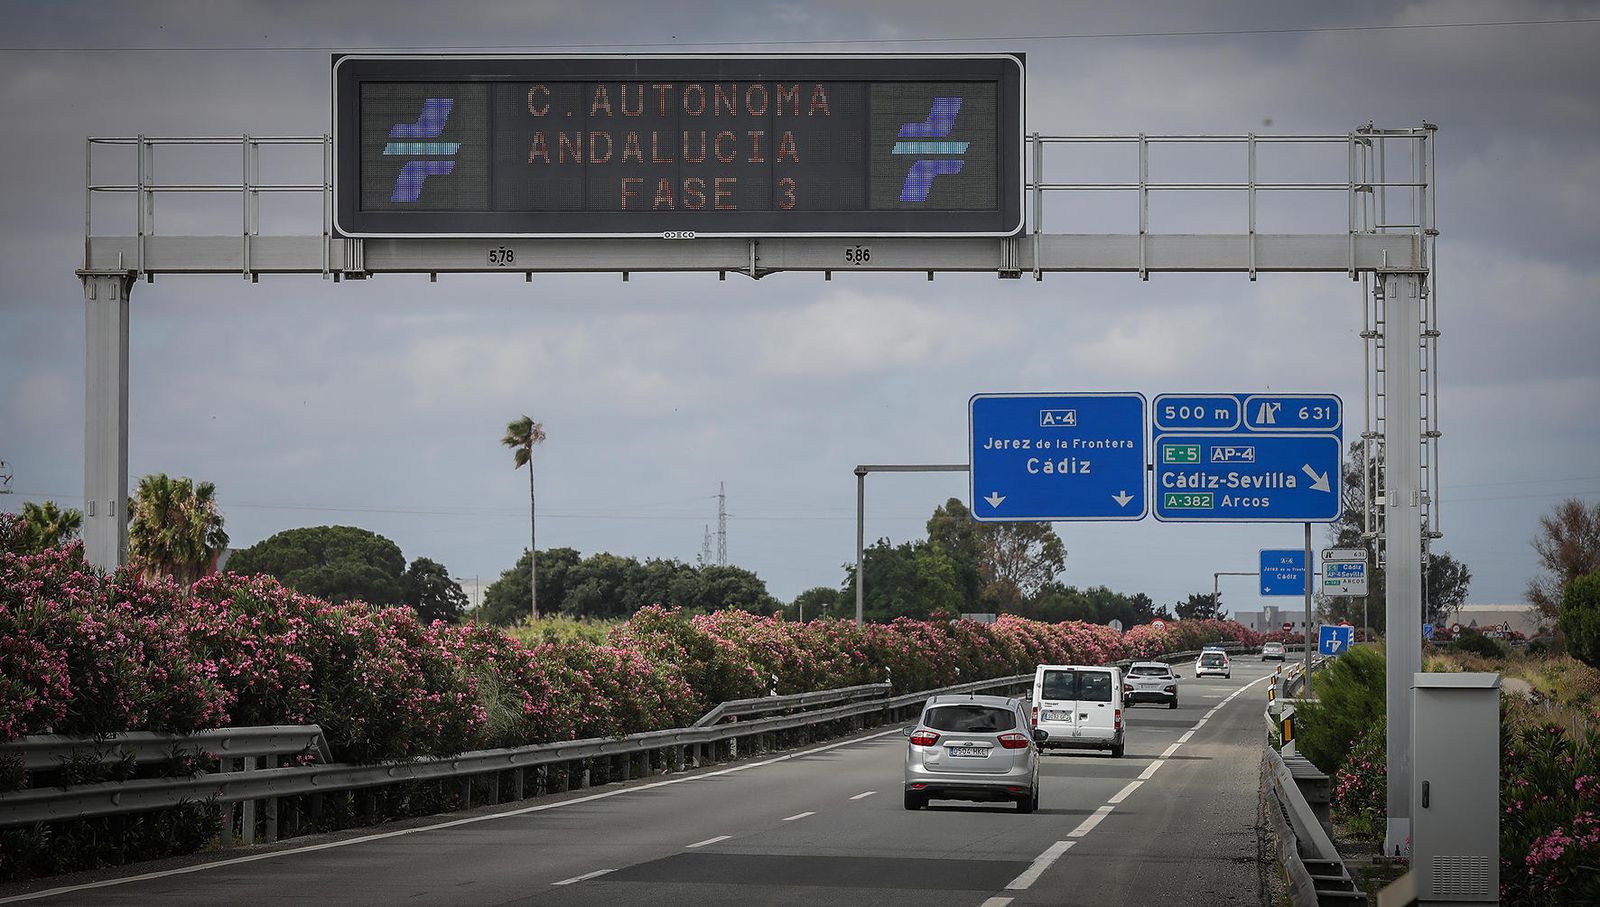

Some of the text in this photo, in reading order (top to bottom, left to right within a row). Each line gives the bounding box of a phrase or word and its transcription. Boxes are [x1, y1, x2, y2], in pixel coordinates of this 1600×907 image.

[528, 130, 800, 164] ANDALUCIA
[621, 177, 797, 210] FASE 3
[489, 250, 514, 264] 5,78
[845, 249, 870, 263] 5,86
[1042, 411, 1075, 425] A-4
[1165, 406, 1229, 420] 500 m
[1298, 407, 1331, 420] 631
[984, 437, 1134, 450] Jerez de la Frontera
[1166, 447, 1254, 462] E-5 AP-4
[1027, 456, 1091, 475] Cádiz
[1162, 471, 1297, 489] Cádiz-Sevilla
[1167, 494, 1270, 508] A-382 Arcos
